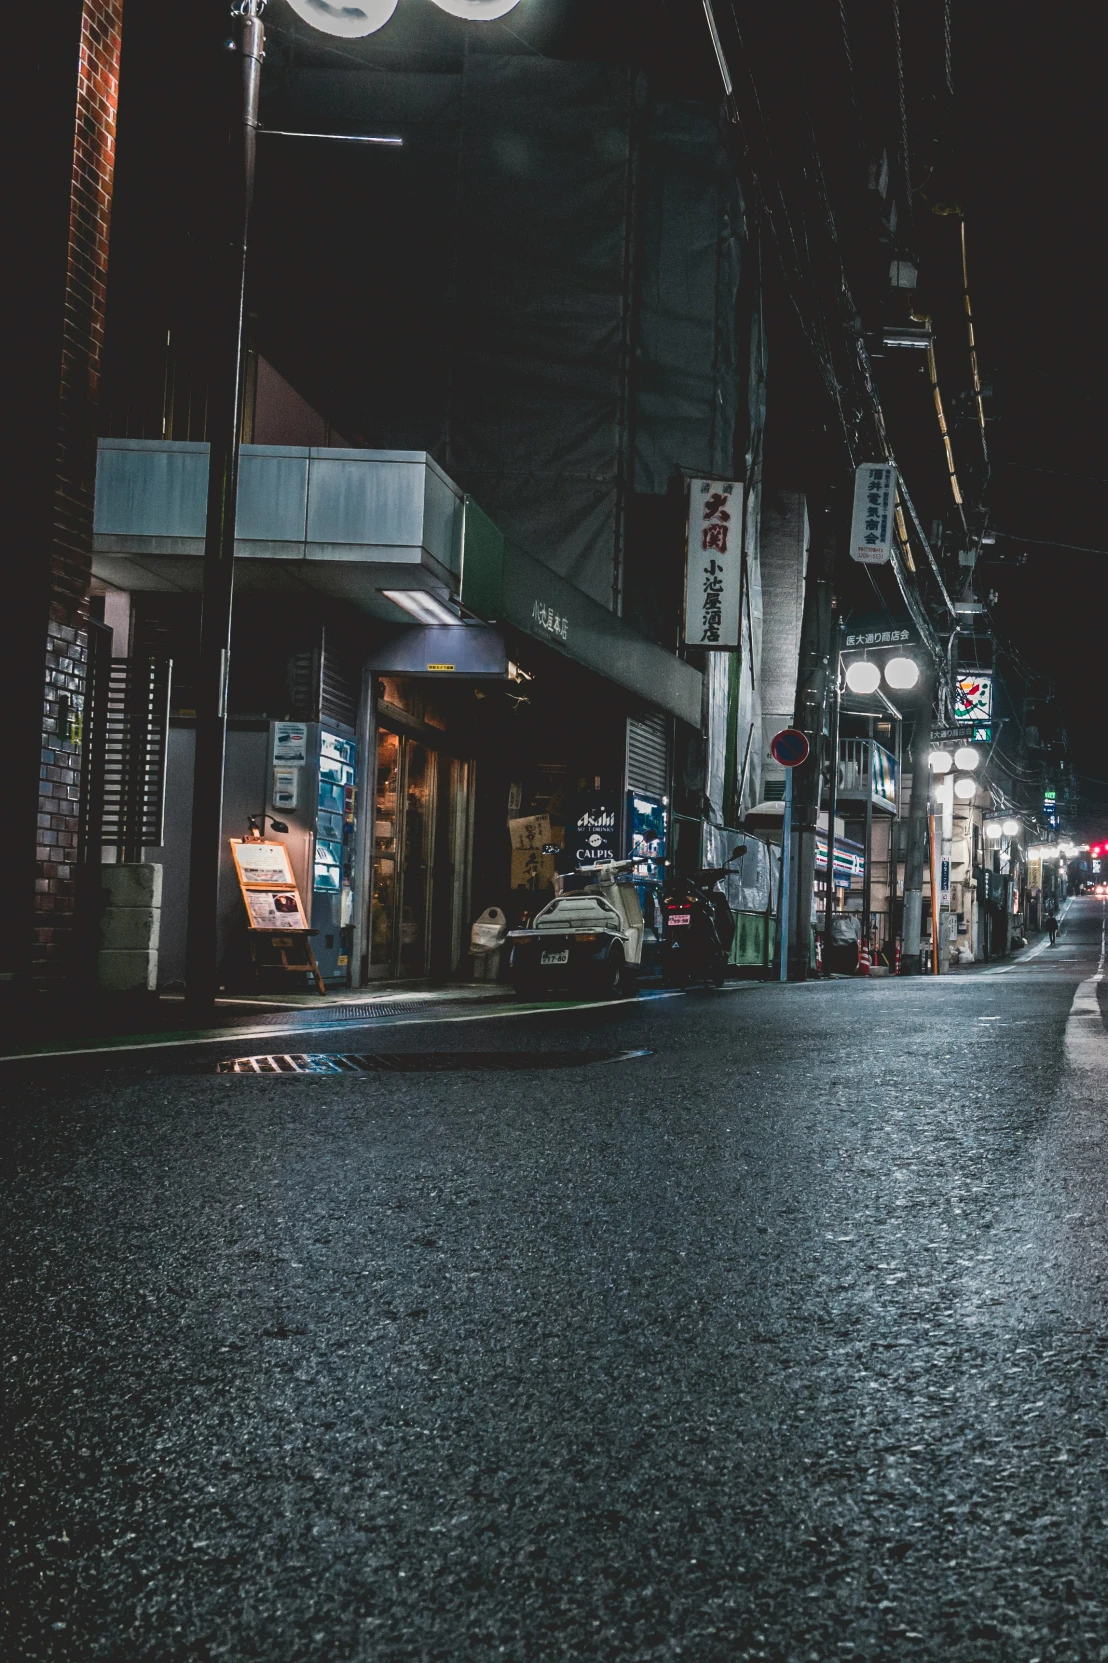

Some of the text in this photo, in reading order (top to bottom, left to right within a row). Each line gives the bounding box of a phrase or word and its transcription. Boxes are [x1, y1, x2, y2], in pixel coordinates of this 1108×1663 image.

[702, 493, 731, 554] 大関
[863, 469, 884, 545] 酒井電気商会
[700, 559, 724, 643] 小池屋酒店
[846, 629, 910, 646] 医大通り商店会
[577, 811, 615, 827] Asahi
[576, 849, 614, 860] CALPIS
